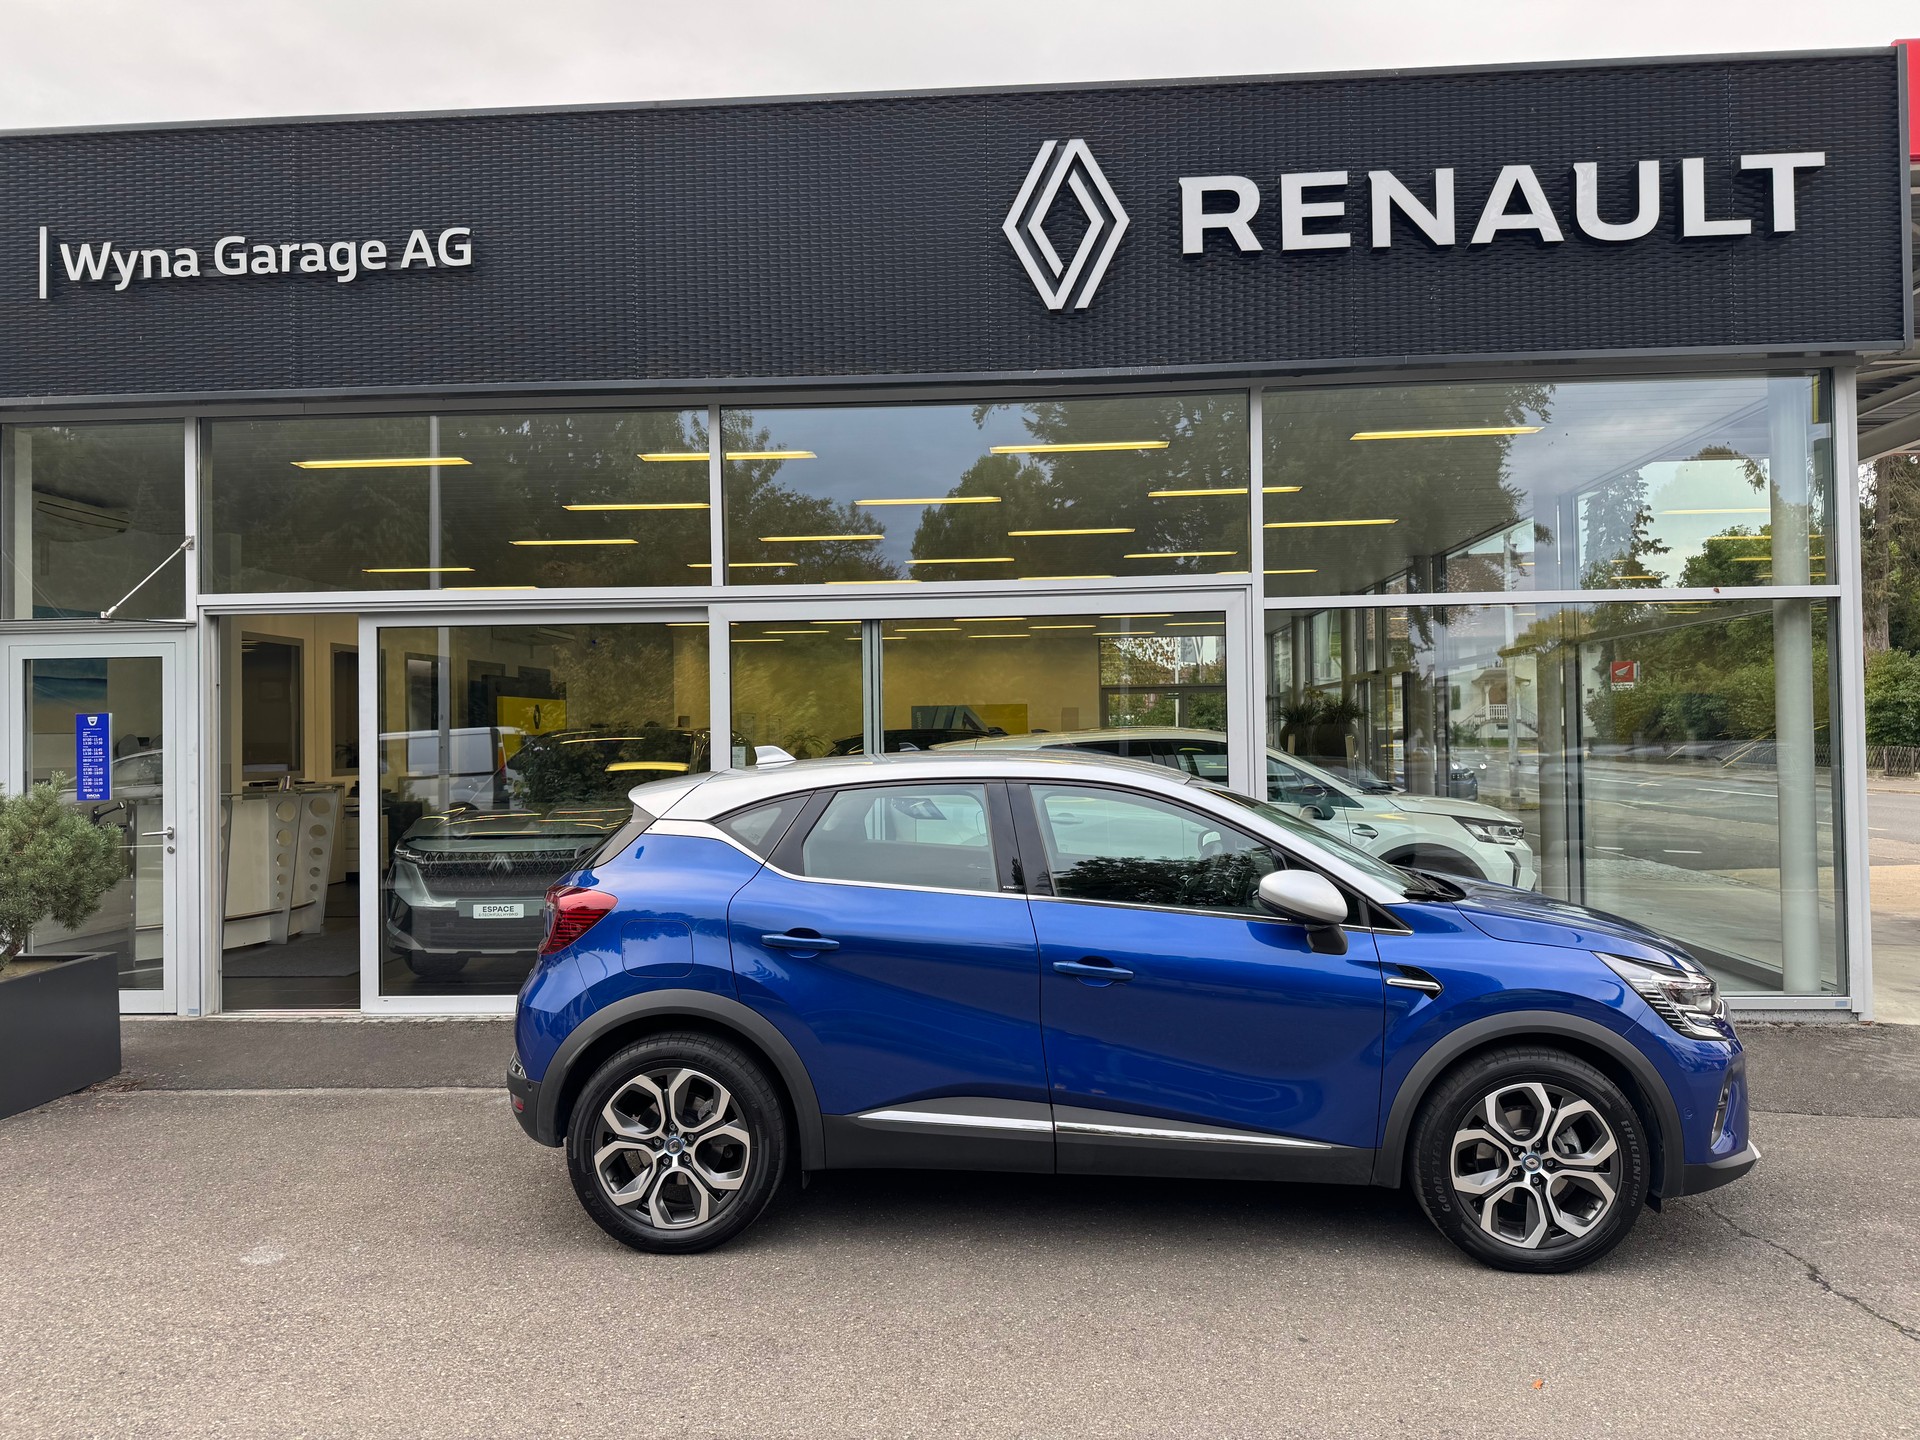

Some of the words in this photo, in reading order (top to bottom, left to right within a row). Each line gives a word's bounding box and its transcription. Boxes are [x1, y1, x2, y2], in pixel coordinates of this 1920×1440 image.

[1179, 151, 1826, 254] RENAULT
[60, 241, 199, 291] Wyna
[213, 235, 387, 283] Garage
[400, 226, 473, 269] AG
